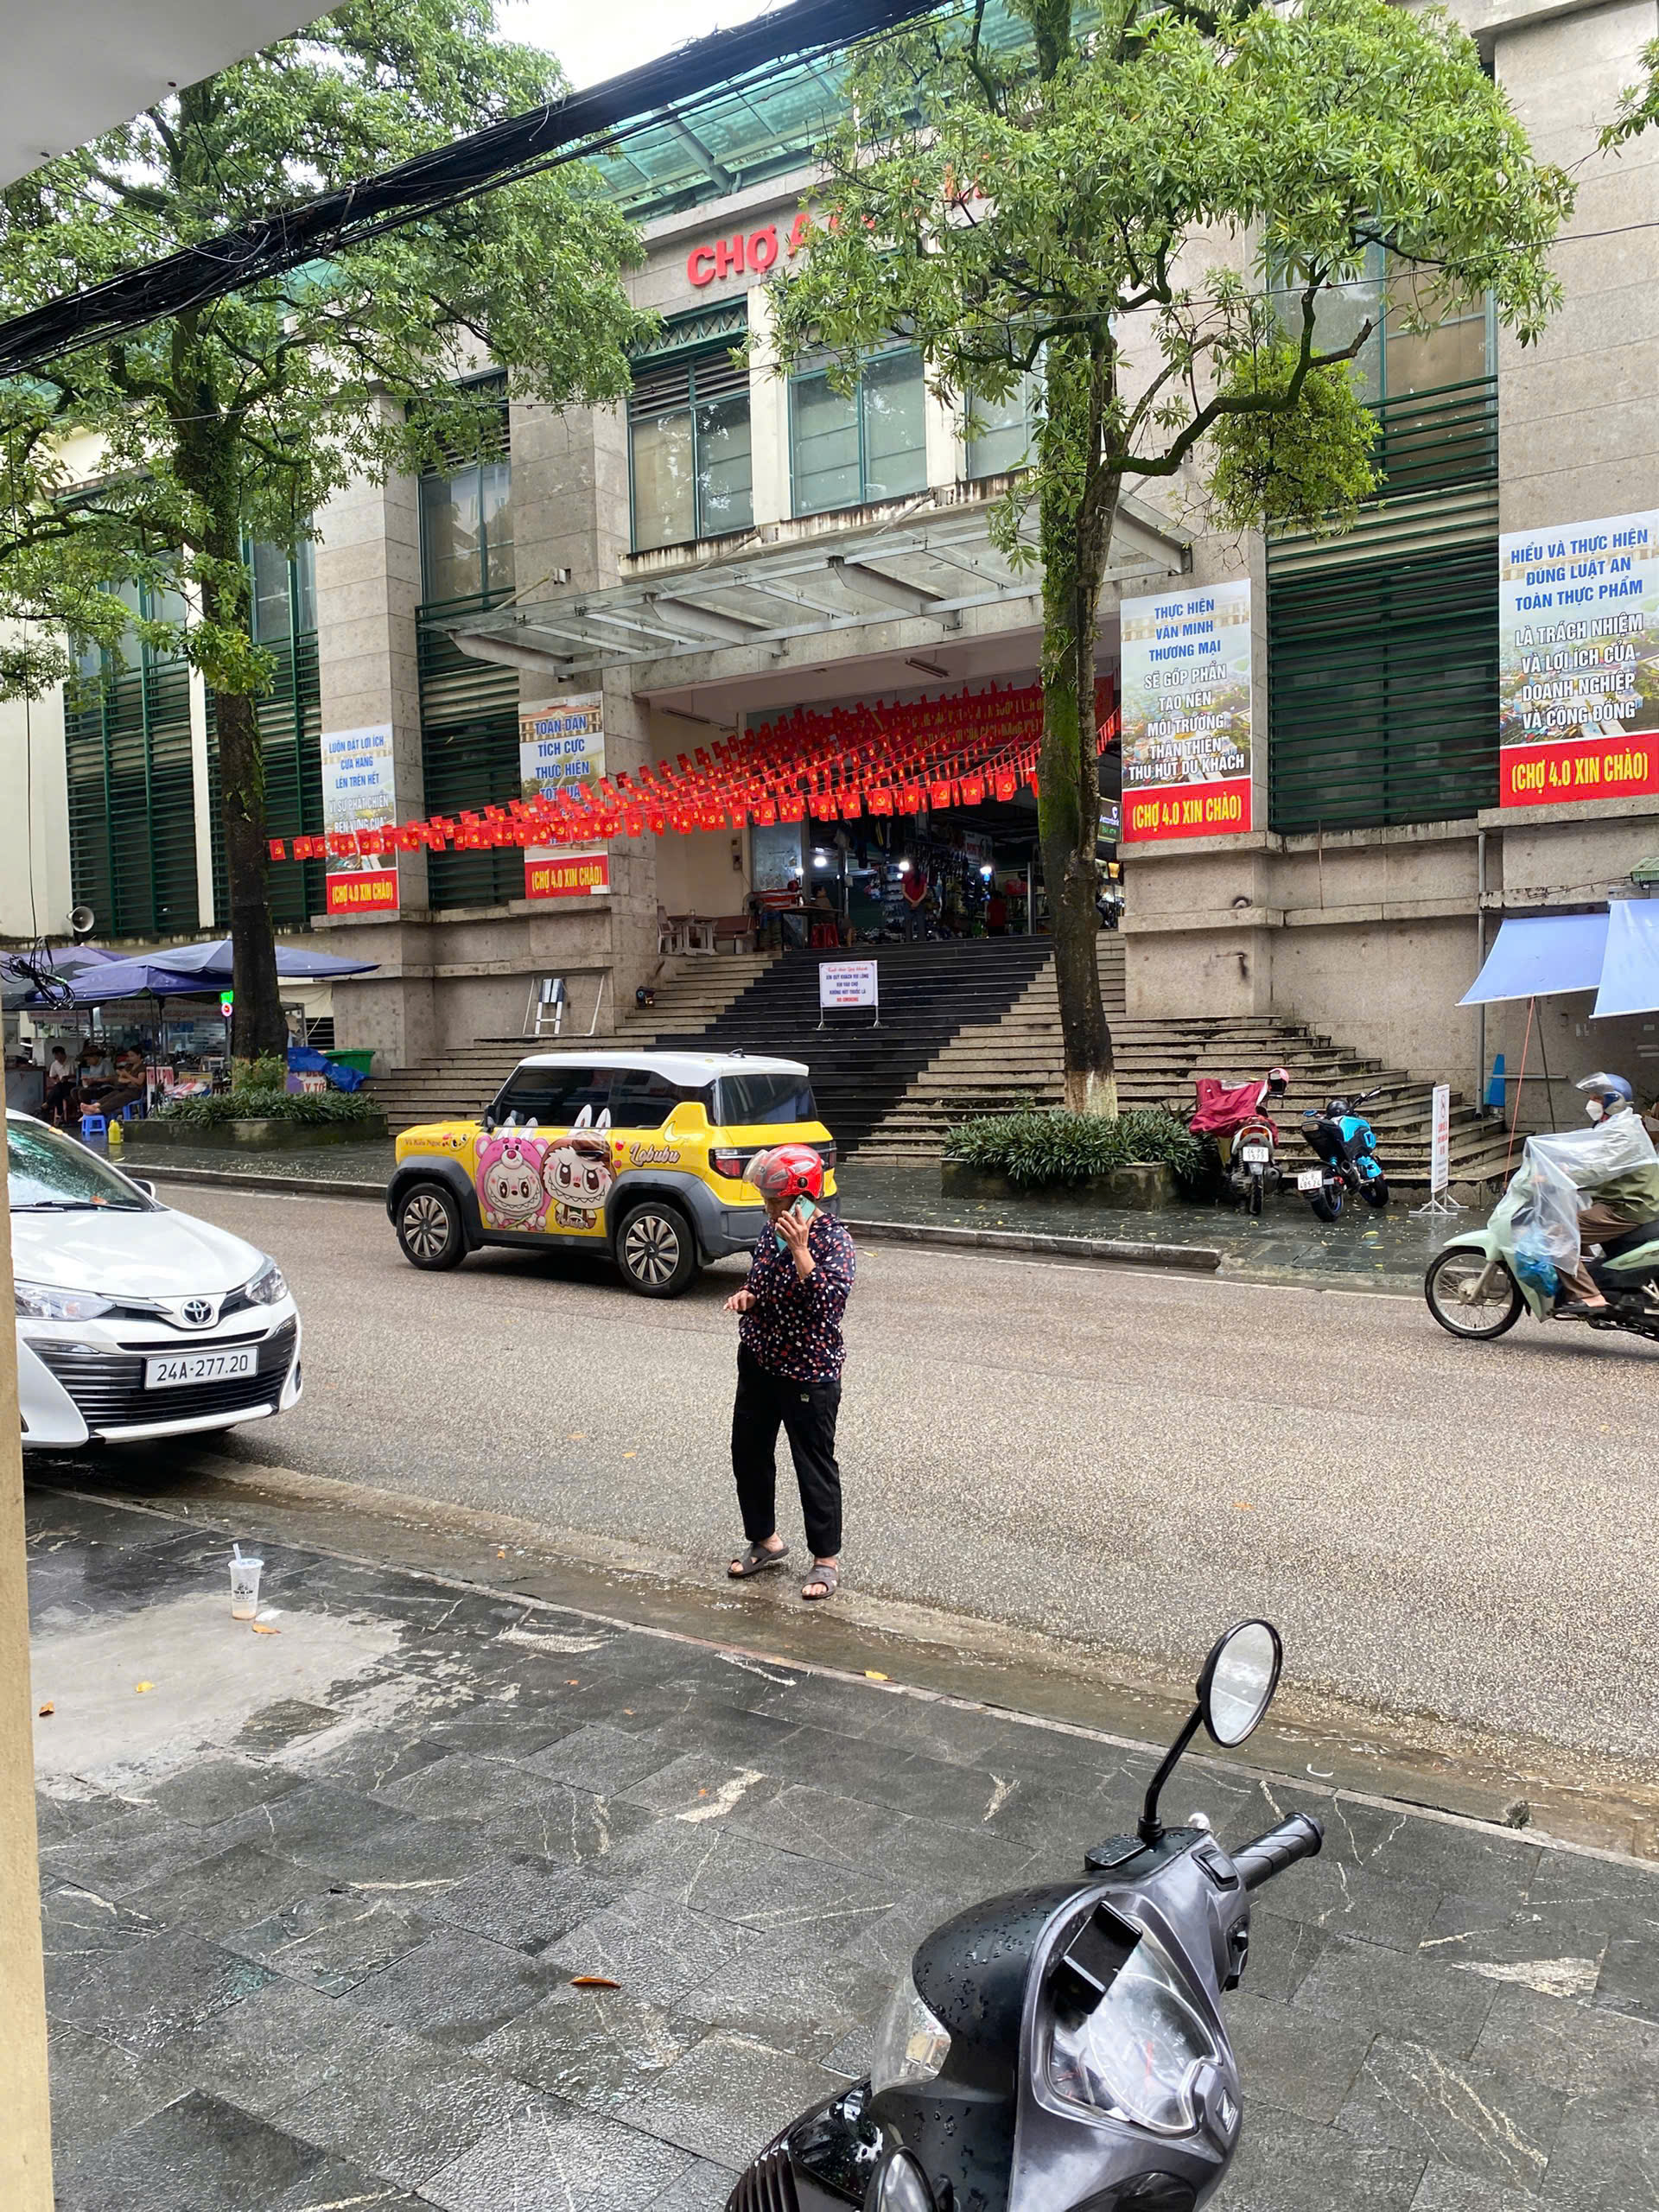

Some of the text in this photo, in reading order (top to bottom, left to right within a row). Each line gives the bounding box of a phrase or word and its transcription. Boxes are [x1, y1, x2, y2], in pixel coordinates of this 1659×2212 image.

[687, 224, 778, 286] CHỢ
[1511, 528, 1649, 563] HIỂU VÀ THỰC HIỆN
[1526, 556, 1631, 586] ĐÚNG LUẬT AN
[1515, 575, 1643, 612] TOÀN THỰC PHẨM
[1154, 598, 1215, 620] THỰC HIỆN
[1156, 620, 1213, 640] VĂN MINH
[1515, 612, 1643, 648] LÀ TRÁCH NHIỆM
[1148, 639, 1221, 662] THƯƠNG MẠI
[1521, 640, 1636, 675] VÀ LỢI ÍCH CỦA
[1144, 660, 1227, 690] SẼ GÓP PHẦN
[1522, 671, 1636, 702] DOANH NGHIỆP
[1158, 690, 1212, 714] TẠO NÊN
[1522, 698, 1636, 730] VÀ CỘNG ĐỒNG
[1147, 713, 1224, 738] MÔI TRƯỜNG
[537, 739, 585, 757] TÍCH CỰC
[1149, 735, 1223, 760] THÂN THIỆN
[536, 760, 589, 782] THỰC HIỆN
[1128, 753, 1245, 781] THU HÚT DU KHÁCH
[1511, 747, 1649, 794] (CHỢ 4.0 XIN CHÀO)
[1133, 800, 1160, 832] (CHỢ
[1161, 798, 1179, 826] 4.0
[1182, 798, 1203, 823] XIN
[1205, 791, 1243, 822] CHÀO)
[531, 862, 603, 893] (CHỢ 4.0 XIN CHÀO)
[349, 884, 359, 903] 4.0
[359, 883, 372, 901] XIN
[629, 1143, 681, 1167] Labubu
[156, 1354, 249, 1382] 24A-277.20
